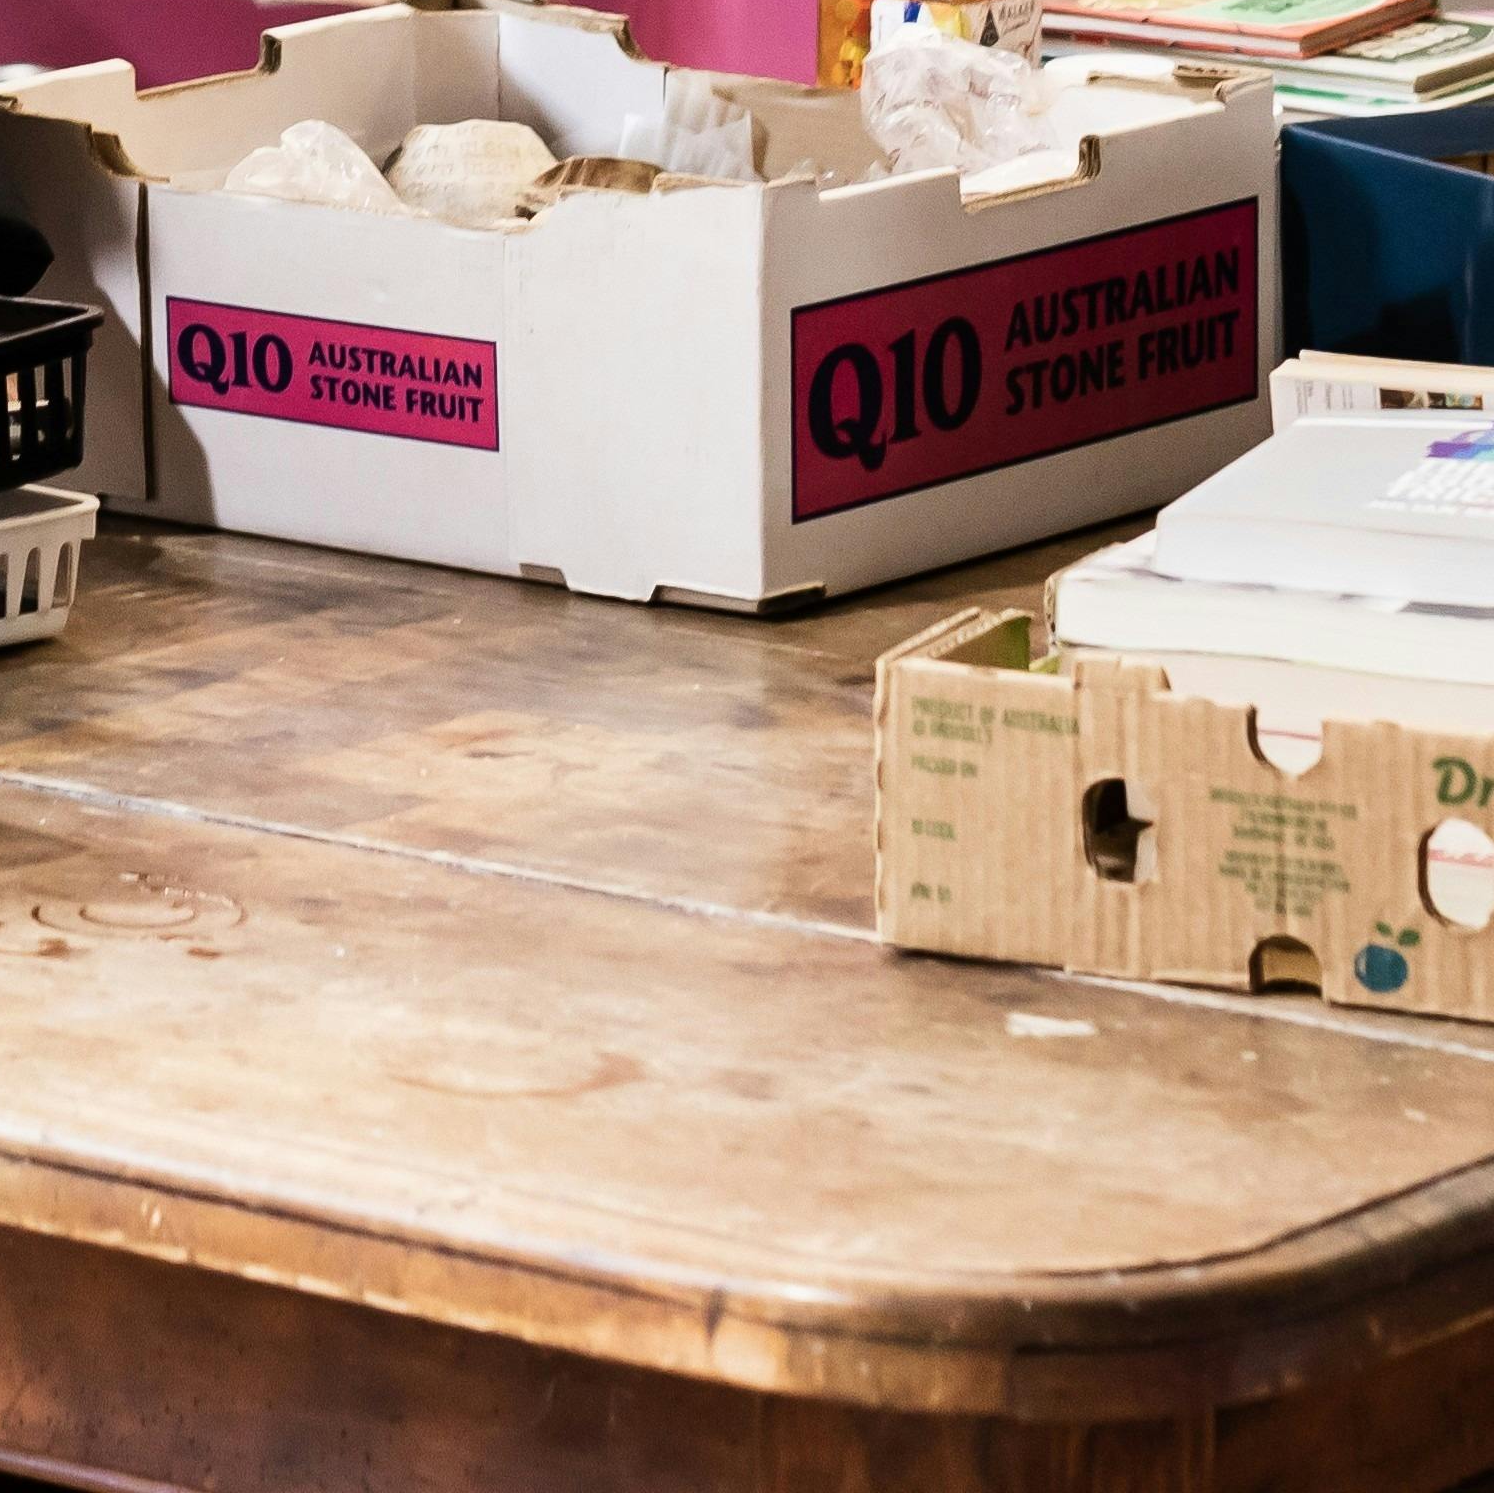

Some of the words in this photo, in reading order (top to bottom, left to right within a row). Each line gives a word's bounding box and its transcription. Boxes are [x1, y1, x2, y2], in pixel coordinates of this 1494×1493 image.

[1004, 246, 1240, 352] AUSTRALIAN
[176, 323, 294, 396] Q10
[308, 340, 483, 390] AUSTRALIAN
[309, 374, 397, 411] STONE
[404, 388, 484, 424] FRUIT
[809, 315, 984, 472] Q10
[1004, 339, 1126, 415] STONE
[1137, 311, 1242, 381] FRUIT
